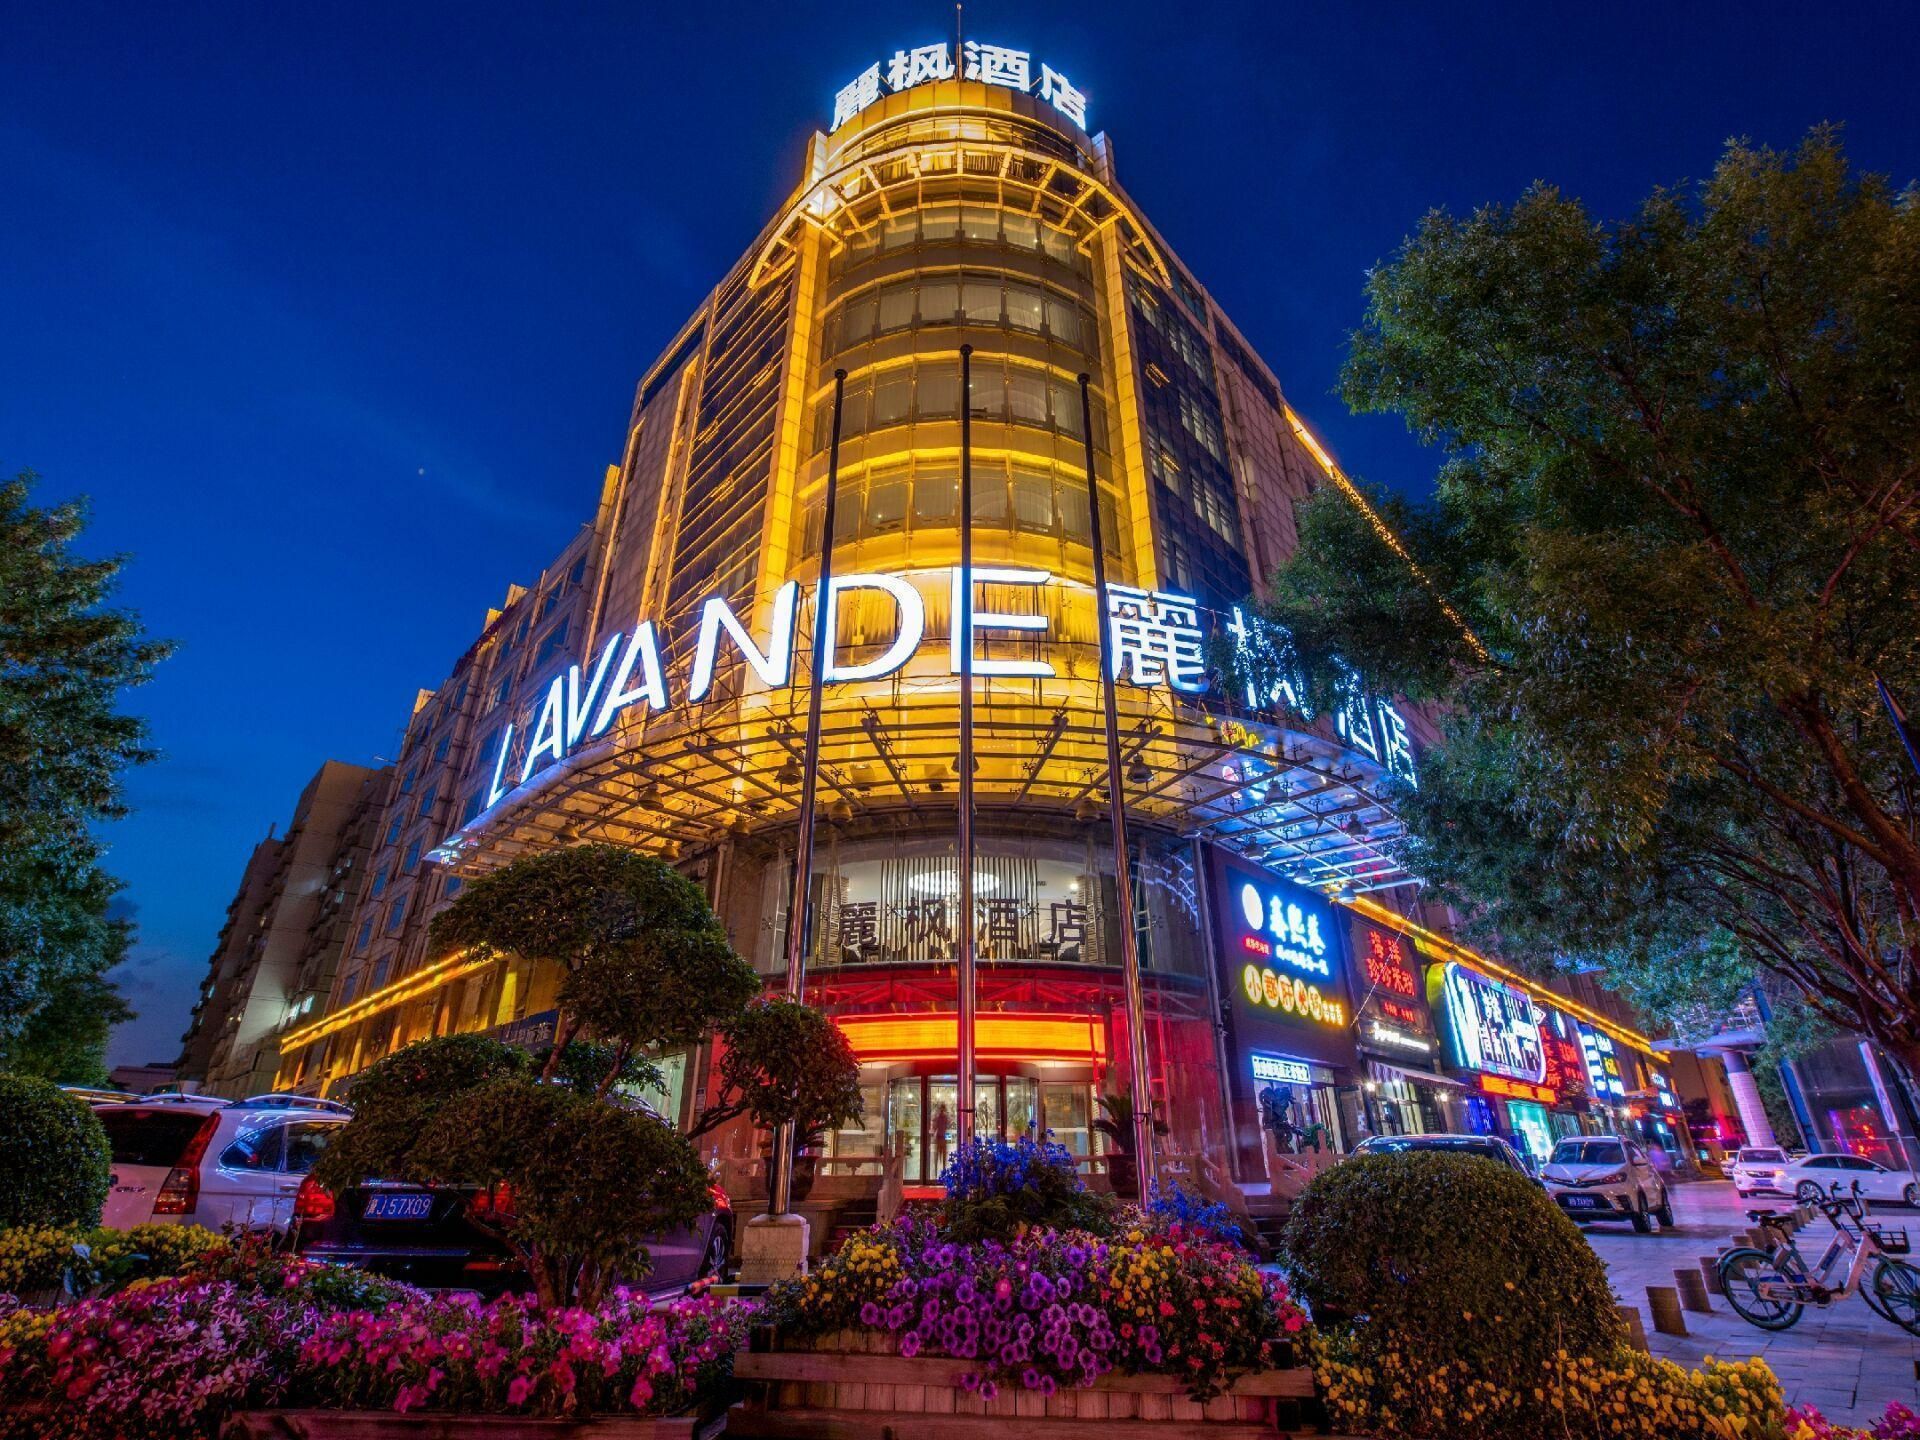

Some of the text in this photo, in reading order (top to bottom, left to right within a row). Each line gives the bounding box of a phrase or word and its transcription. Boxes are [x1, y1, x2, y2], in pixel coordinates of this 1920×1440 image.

[486, 566, 1057, 810] LAVANDE
[837, 896, 1088, 946] 麗枫酒店
